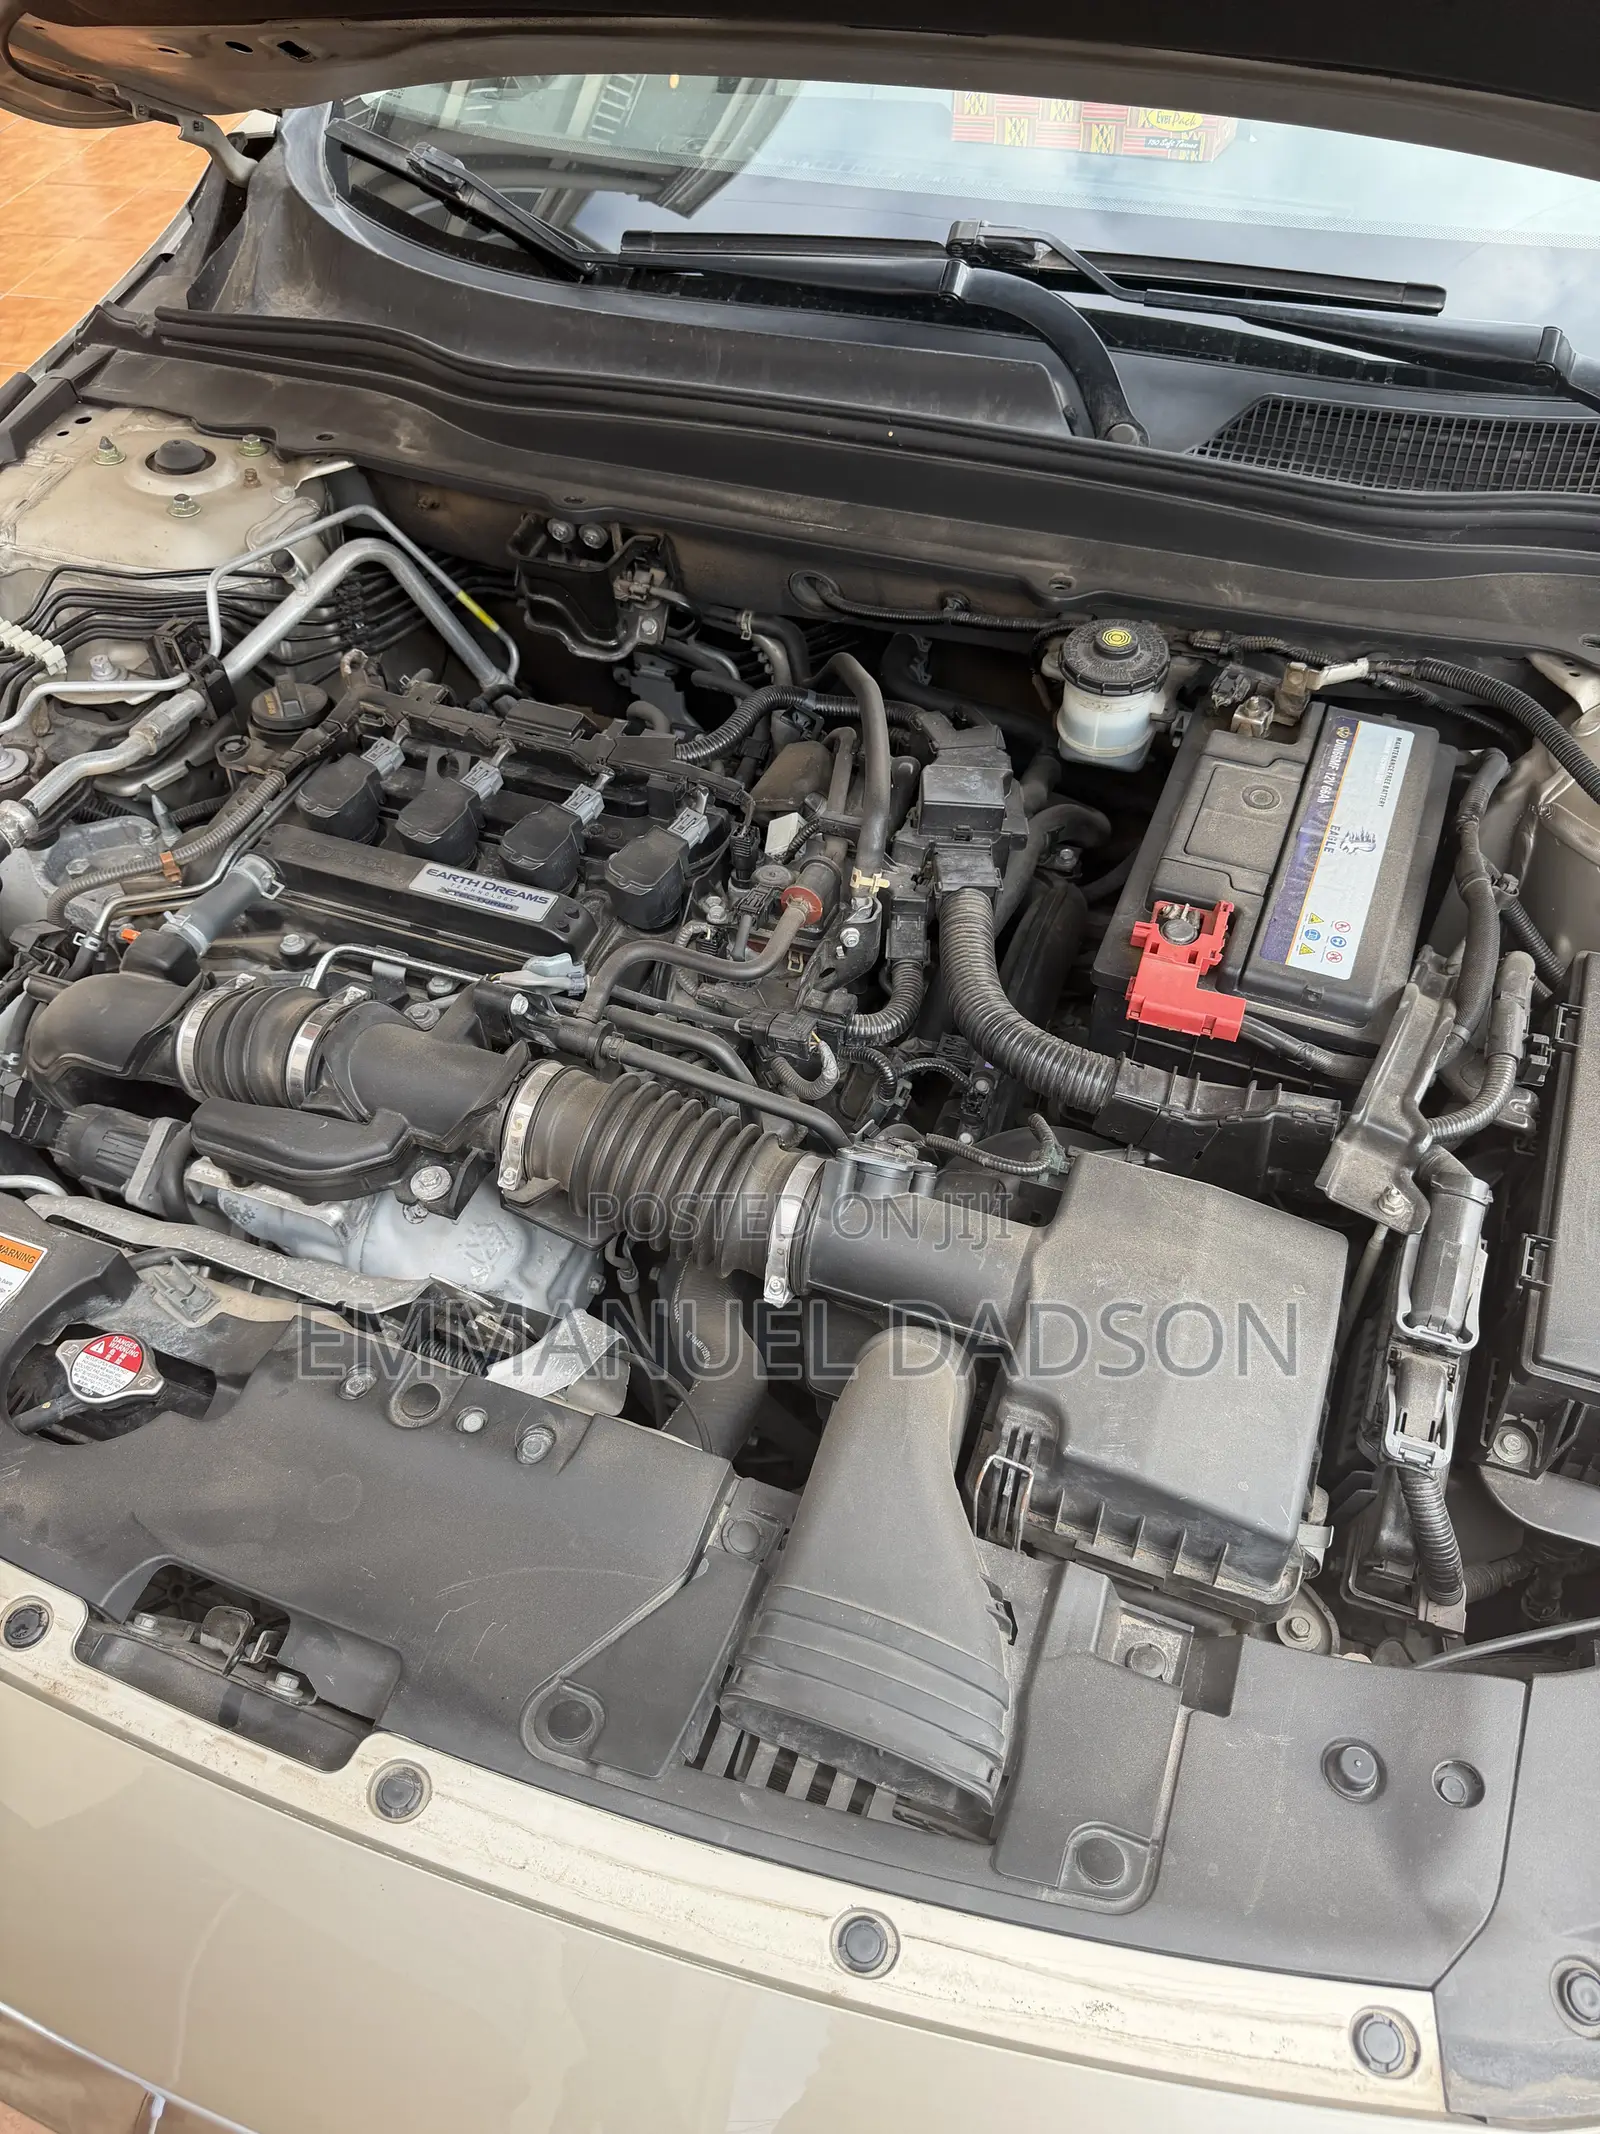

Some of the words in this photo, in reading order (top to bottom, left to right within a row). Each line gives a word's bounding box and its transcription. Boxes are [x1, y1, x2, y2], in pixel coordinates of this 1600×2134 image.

[1386, 736, 1403, 773] MAINTENANCE
[1325, 771, 1337, 787] 12V
[1383, 772, 1394, 786] FREE
[1378, 785, 1391, 808] BATTERY
[1323, 824, 1341, 854] EAGLE
[426, 868, 481, 888] EARTH
[482, 880, 551, 905] DREAMS
[450, 882, 514, 903] TECHNOLOGY
[112, 1335, 139, 1350] DANGER
